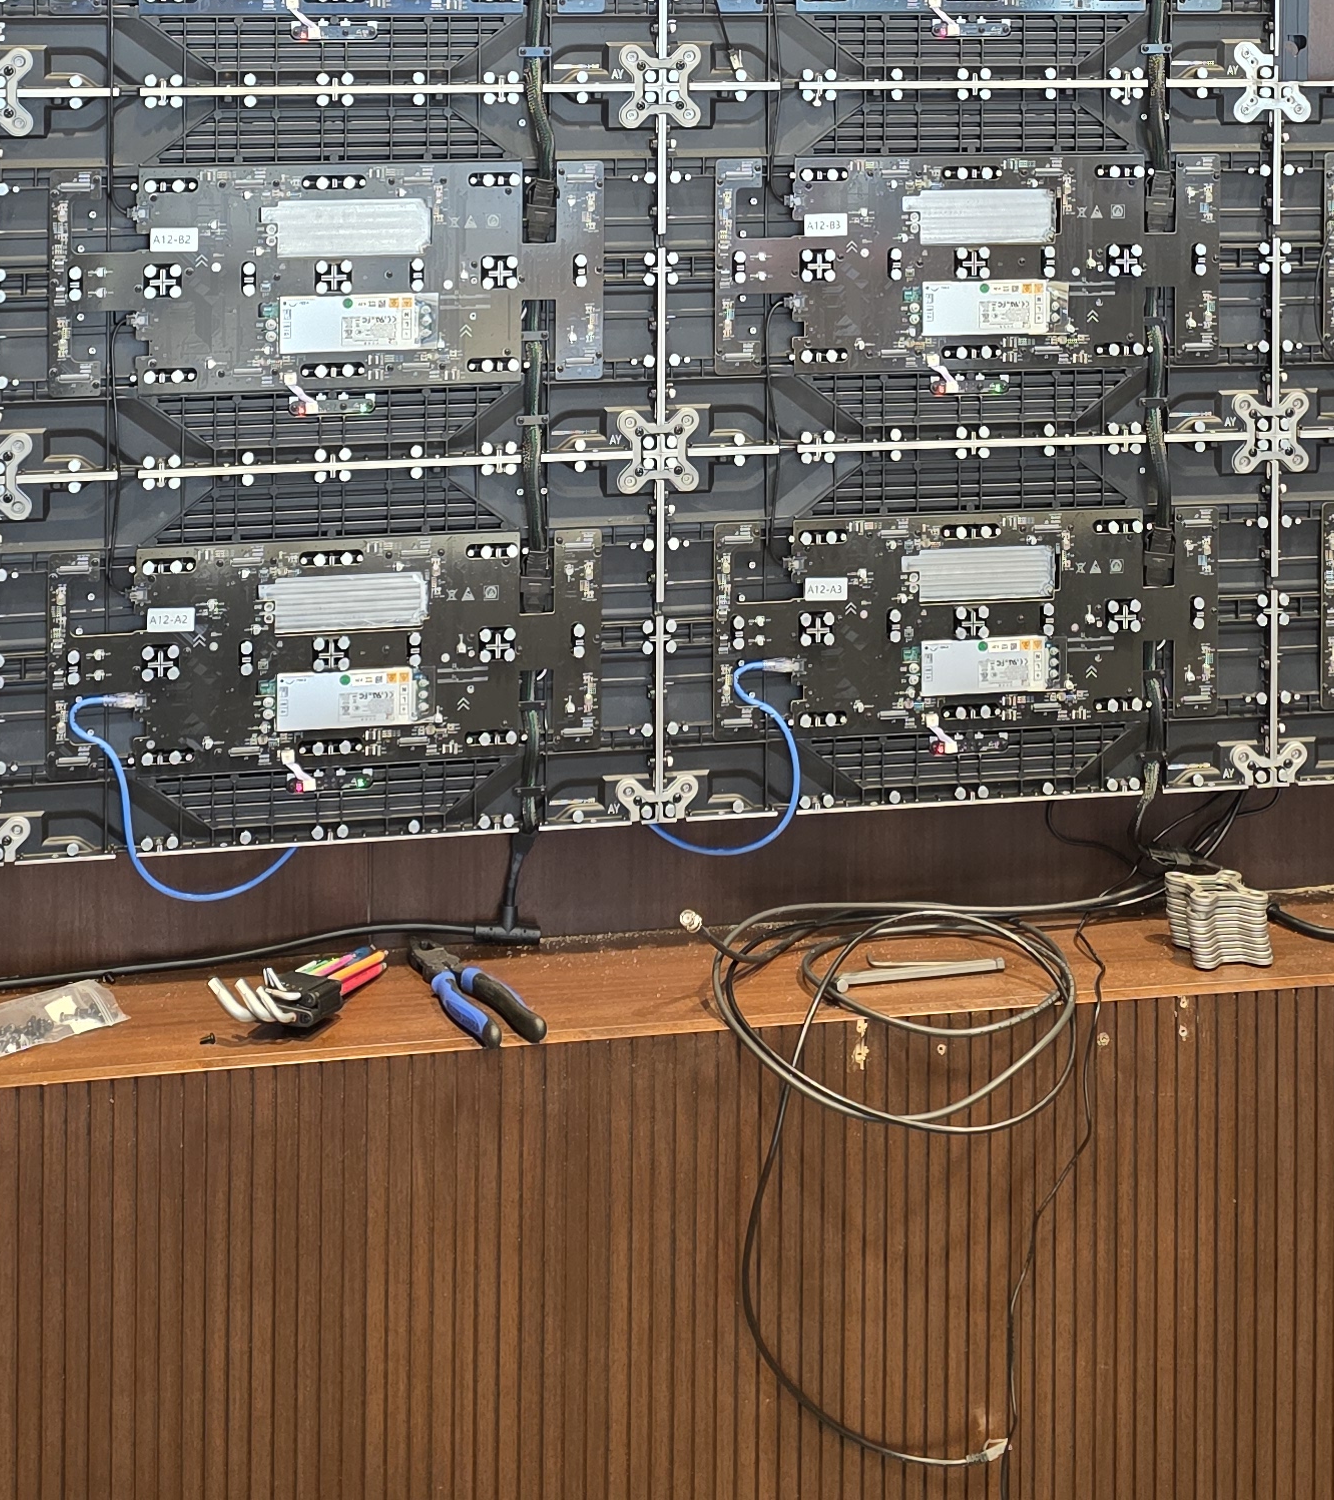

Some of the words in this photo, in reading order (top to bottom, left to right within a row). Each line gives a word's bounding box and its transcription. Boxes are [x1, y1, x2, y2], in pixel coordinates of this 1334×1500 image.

[611, 69, 624, 79] AY
[1227, 65, 1239, 75] AY
[806, 219, 841, 231] A12-B3
[152, 234, 191, 245] A12-B2
[1223, 417, 1237, 426] AY
[608, 435, 622, 445] AY
[807, 584, 844, 595] A12-A3
[149, 614, 188, 625] A12-A2
[1223, 768, 1235, 778] AY
[607, 804, 621, 814] AY
